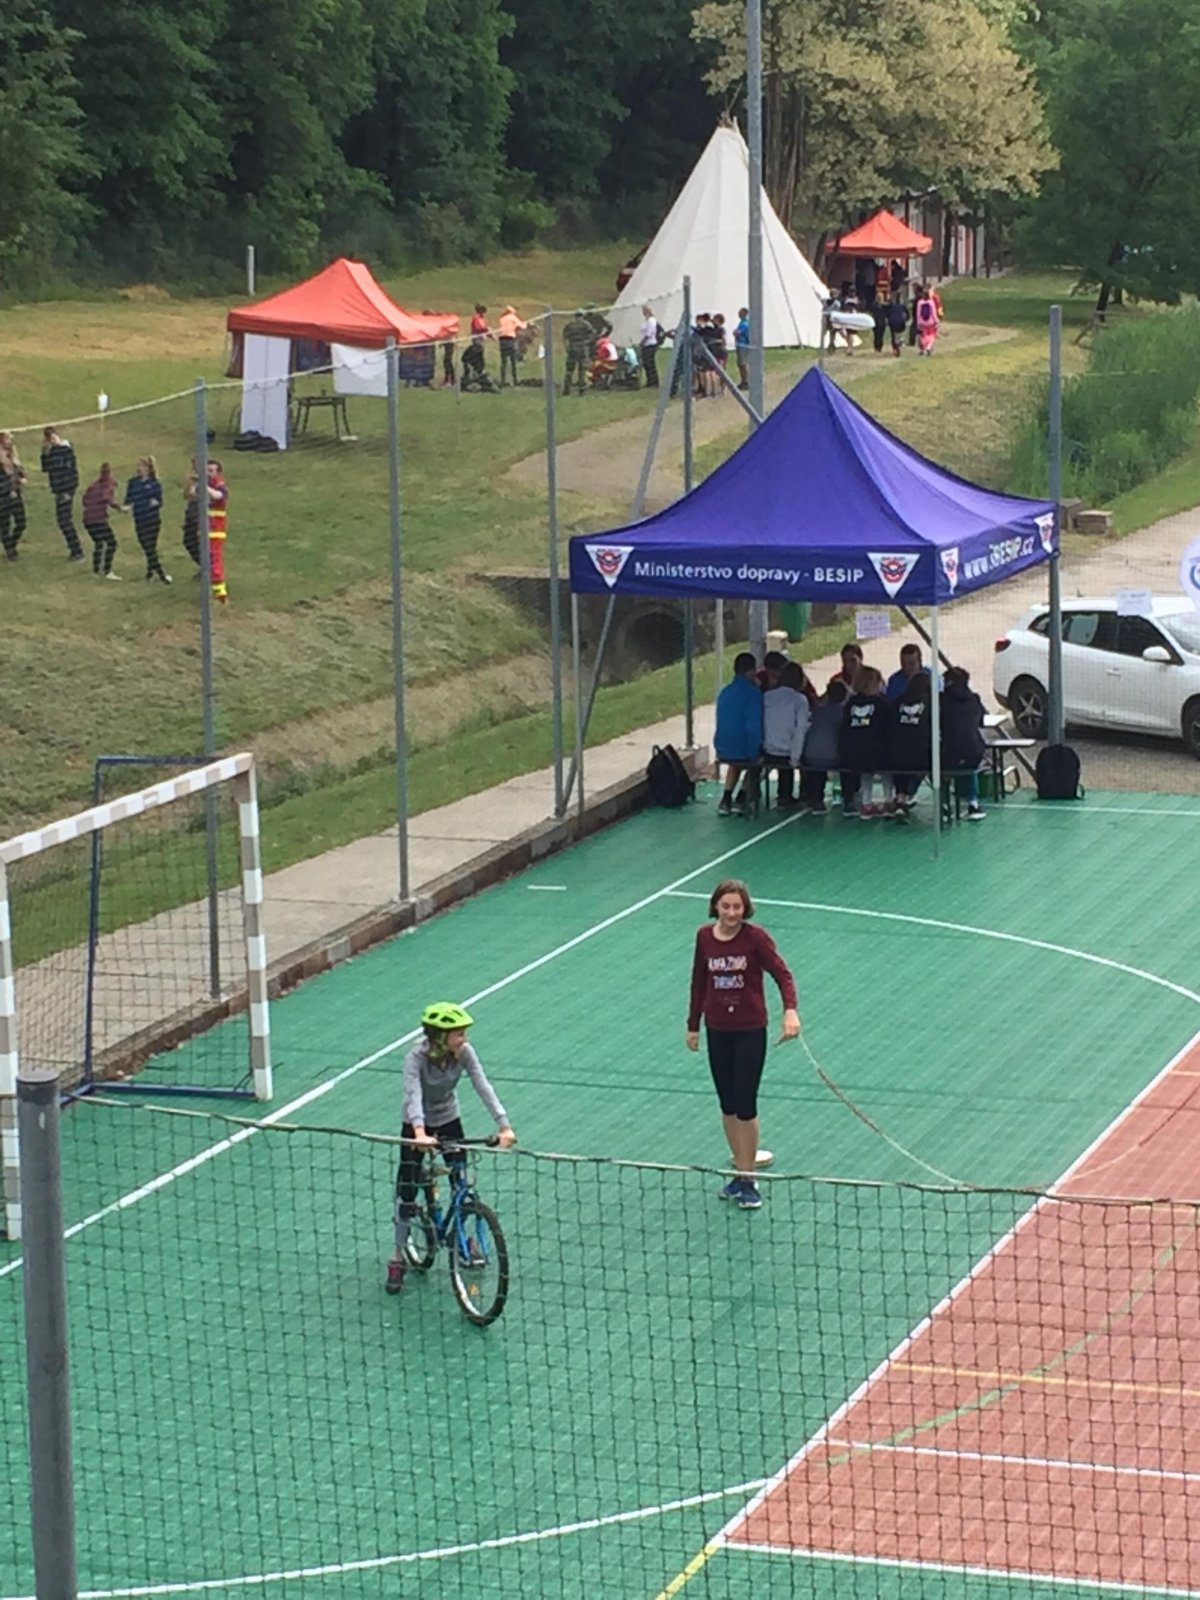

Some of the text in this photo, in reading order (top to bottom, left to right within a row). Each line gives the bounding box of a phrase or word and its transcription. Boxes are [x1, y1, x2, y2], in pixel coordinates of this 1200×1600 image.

[635, 562, 732, 579] Ministerstvo
[737, 564, 800, 585] dopravy
[814, 567, 864, 583] BESIP
